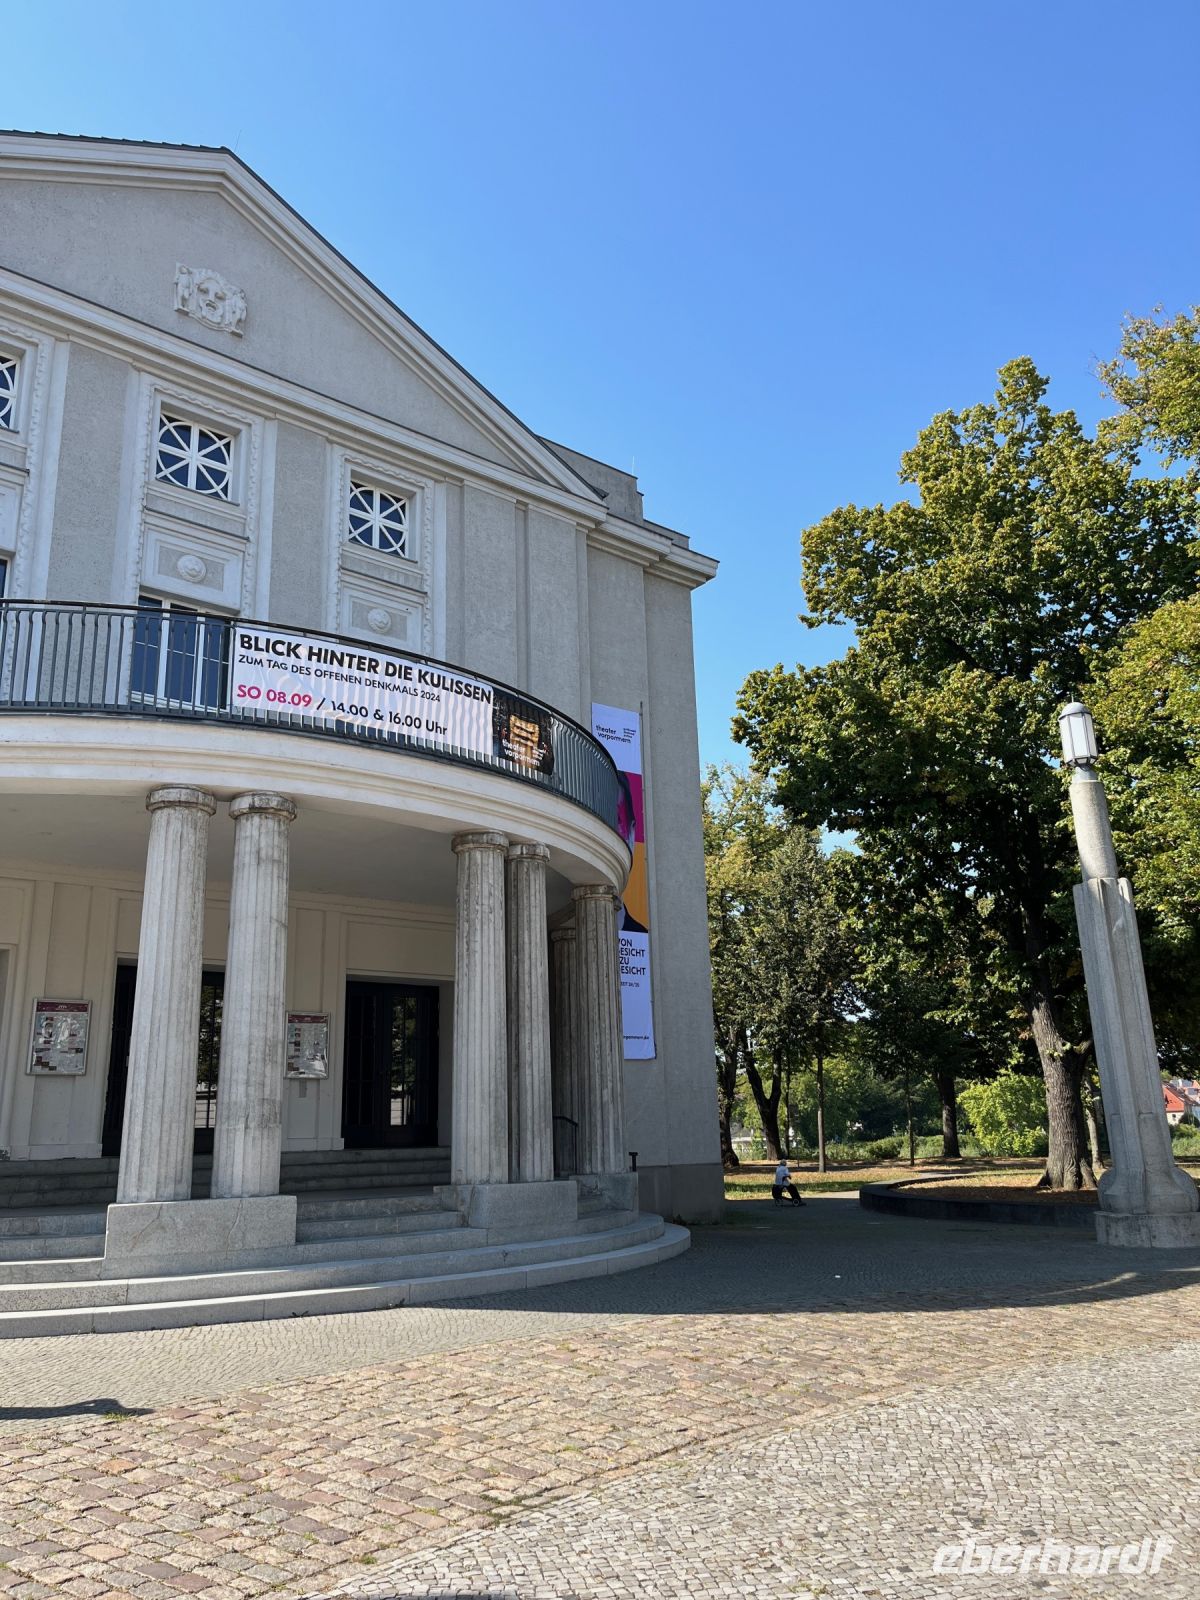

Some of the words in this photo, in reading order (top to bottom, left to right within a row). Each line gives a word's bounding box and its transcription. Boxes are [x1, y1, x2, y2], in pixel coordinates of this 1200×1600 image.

[238, 654, 264, 668] ZUM
[266, 659, 288, 670] TAG
[291, 664, 311, 676] DES
[314, 668, 362, 686] OFFENEN
[364, 678, 419, 697] DENKMALS
[420, 690, 441, 703] 2024
[239, 634, 302, 660] BLICK
[307, 646, 380, 675] HINTER
[384, 661, 413, 682] DIE
[417, 669, 492, 705] KULISSEN
[237, 684, 261, 700] SO
[266, 689, 313, 708] 08.09
[316, 697, 326, 711] /
[331, 700, 369, 719] 14.00
[373, 708, 384, 721] &
[388, 711, 422, 730] 16.00
[425, 719, 448, 736] Uhr
[619, 938, 632, 947] ON
[619, 948, 645, 957] ESICHT
[620, 966, 646, 975] ESICHT
